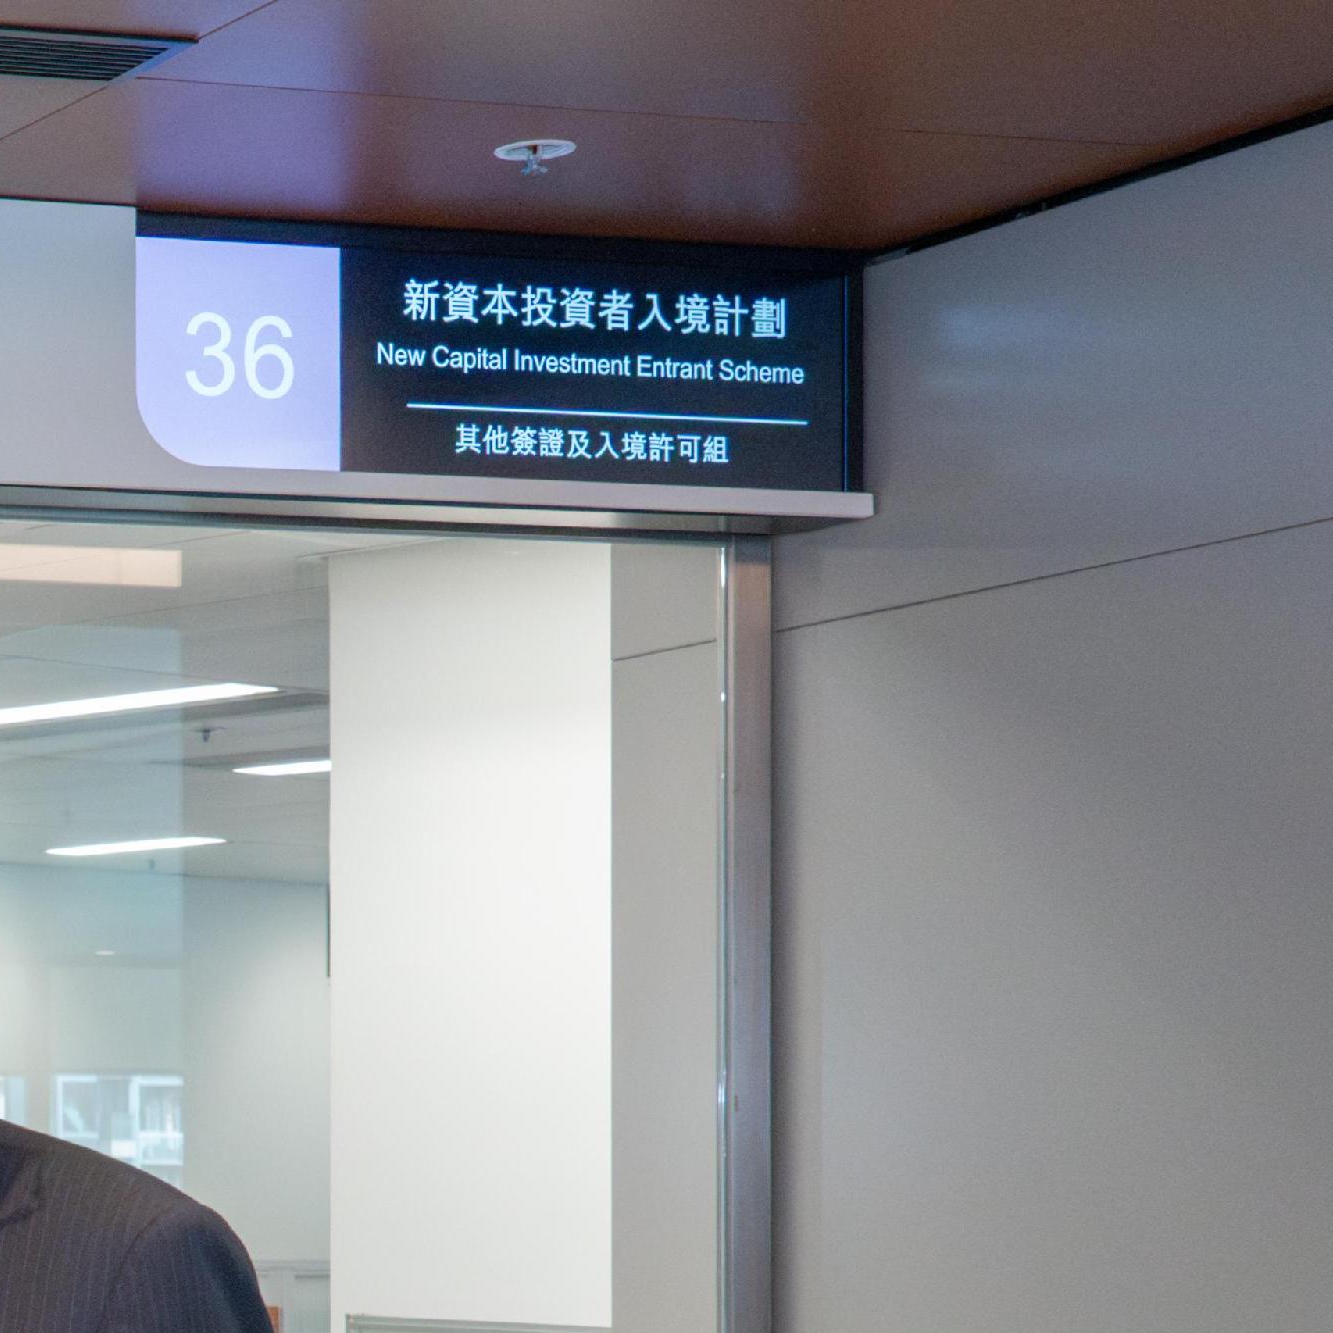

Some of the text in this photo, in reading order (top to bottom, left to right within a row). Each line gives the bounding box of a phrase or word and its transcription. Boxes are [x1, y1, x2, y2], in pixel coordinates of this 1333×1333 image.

[403, 279, 785, 338] 新資本投資者入境計劃
[186, 312, 293, 399] 36
[378, 342, 804, 384] New Capital Investment Entrant Scheme
[455, 424, 730, 464] 其他簽證及入境許可組
